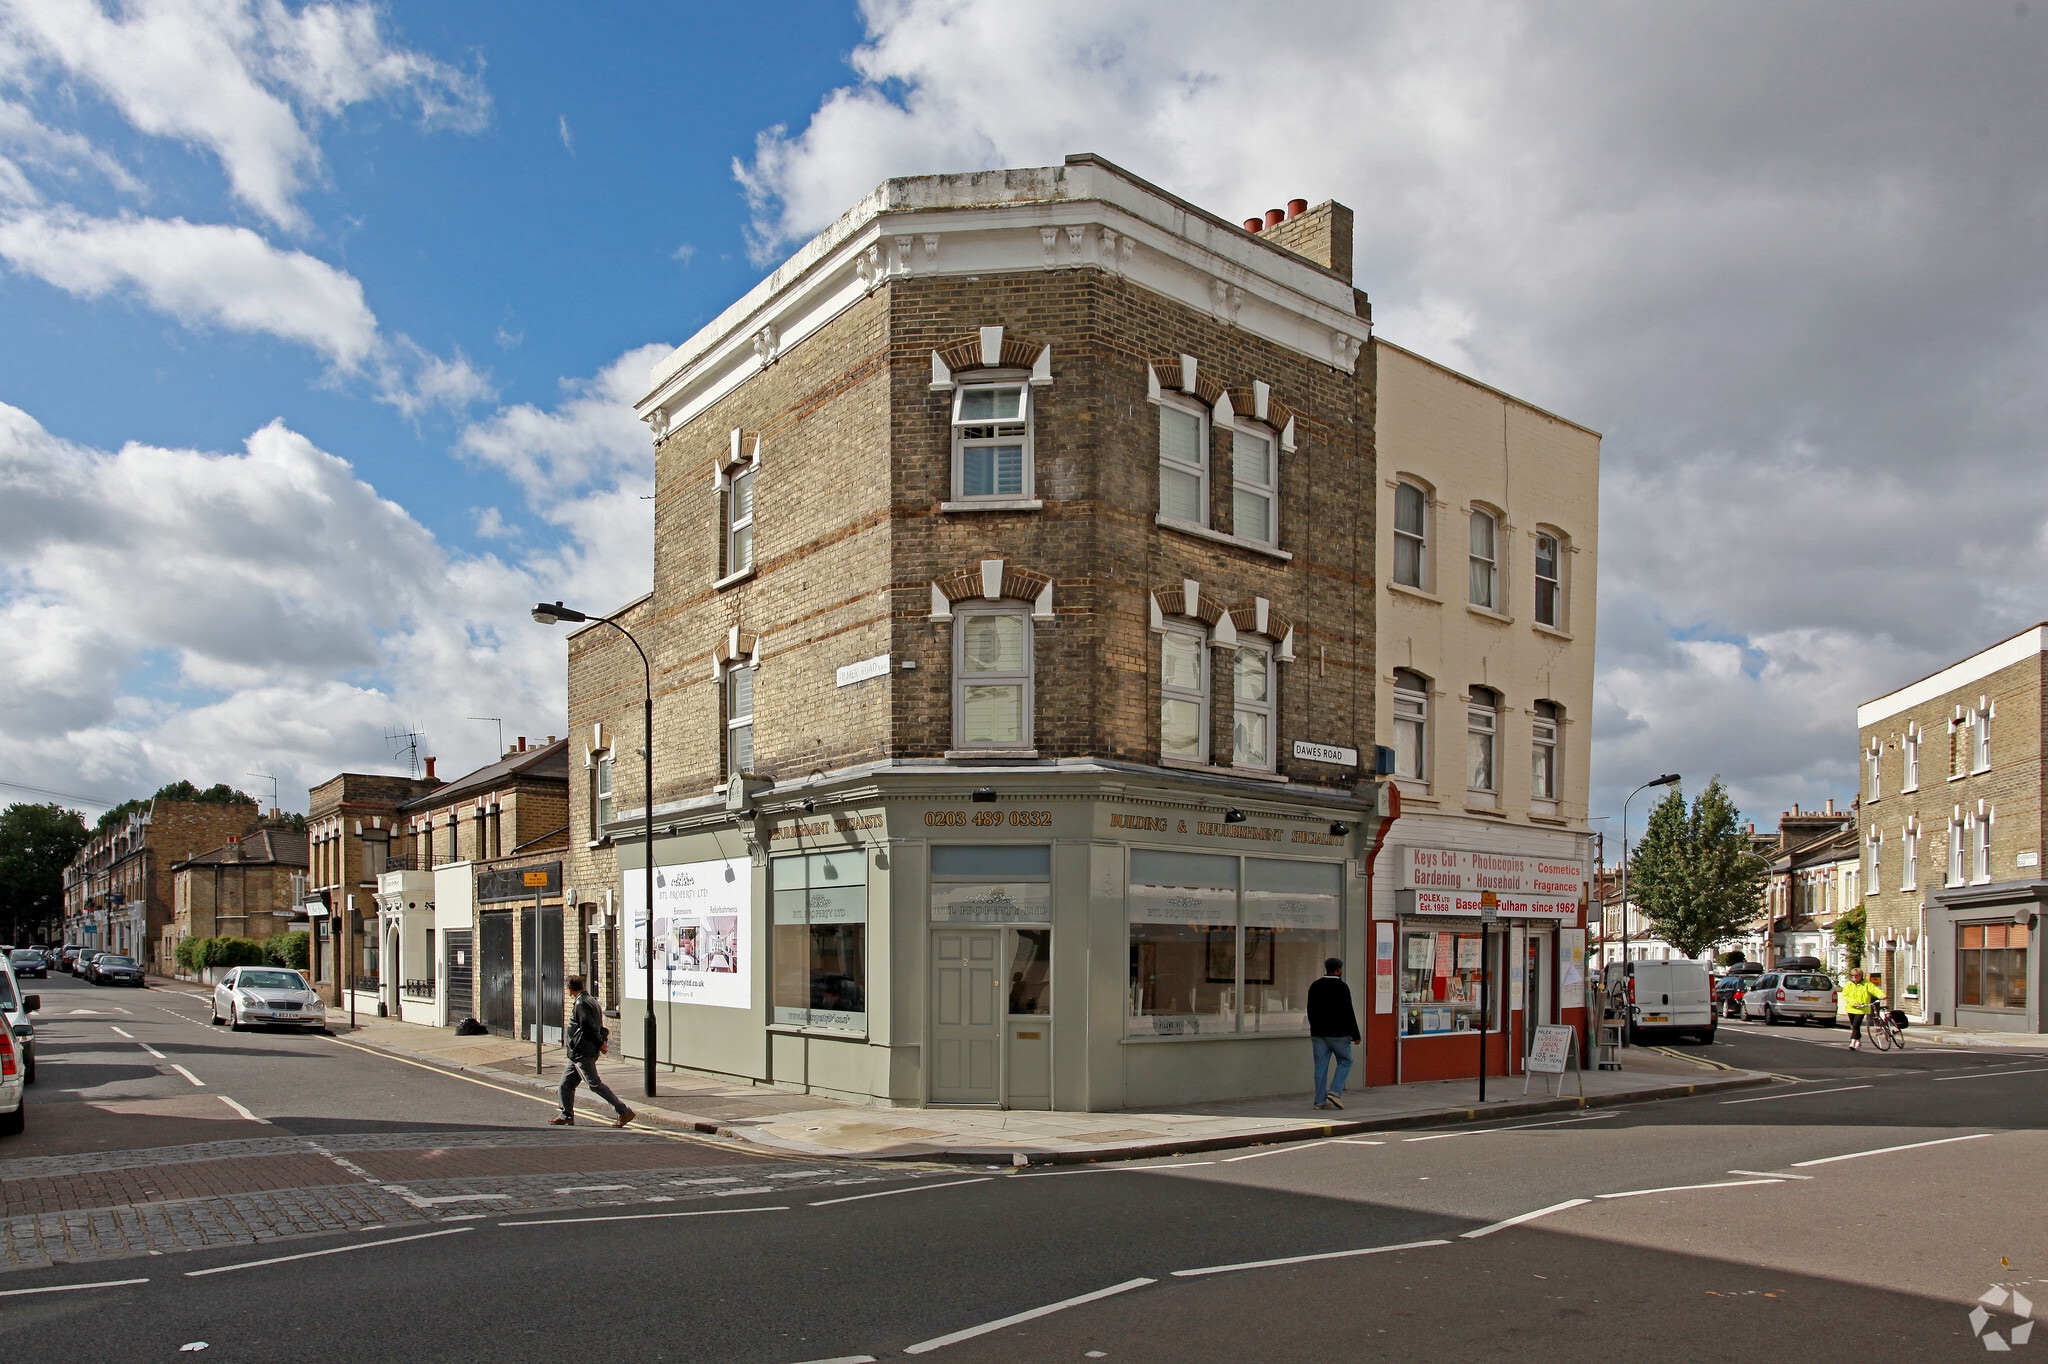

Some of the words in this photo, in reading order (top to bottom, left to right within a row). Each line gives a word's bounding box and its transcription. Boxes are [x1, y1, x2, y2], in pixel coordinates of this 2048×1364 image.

[1296, 745, 1321, 757] DAWES
[1323, 749, 1342, 760] ROAD
[833, 813, 884, 833] SPECIALISTS
[924, 811, 967, 826] 0203
[971, 811, 1005, 826] 489
[1008, 811, 1052, 826] 0332
[1110, 813, 1168, 832] BUILDING
[1176, 820, 1187, 833] &
[1197, 821, 1284, 842] REFURBISHMENT
[1291, 829, 1345, 847] SPECIALISTS
[1414, 848, 1437, 867] Keys
[1441, 851, 1457, 867] Cut
[1472, 853, 1524, 874] Photocopies
[1537, 862, 1581, 876] Cosmetics
[1414, 867, 1461, 889] Gardening
[1476, 872, 1520, 890] Household
[1533, 878, 1577, 893] Fragrances
[659, 891, 668, 900] BTL
[669, 889, 696, 901] PROPERTY
[697, 888, 709, 898] LTD
[1418, 893, 1441, 903] POLEX
[960, 906, 1020, 916] PROPERTY
[1024, 906, 1048, 915] LTD
[1419, 902, 1432, 911] Est.
[1433, 903, 1449, 912] 1958
[1495, 899, 1528, 912] Fulham
[1531, 901, 1553, 913] since
[1555, 902, 1575, 914] 1962
